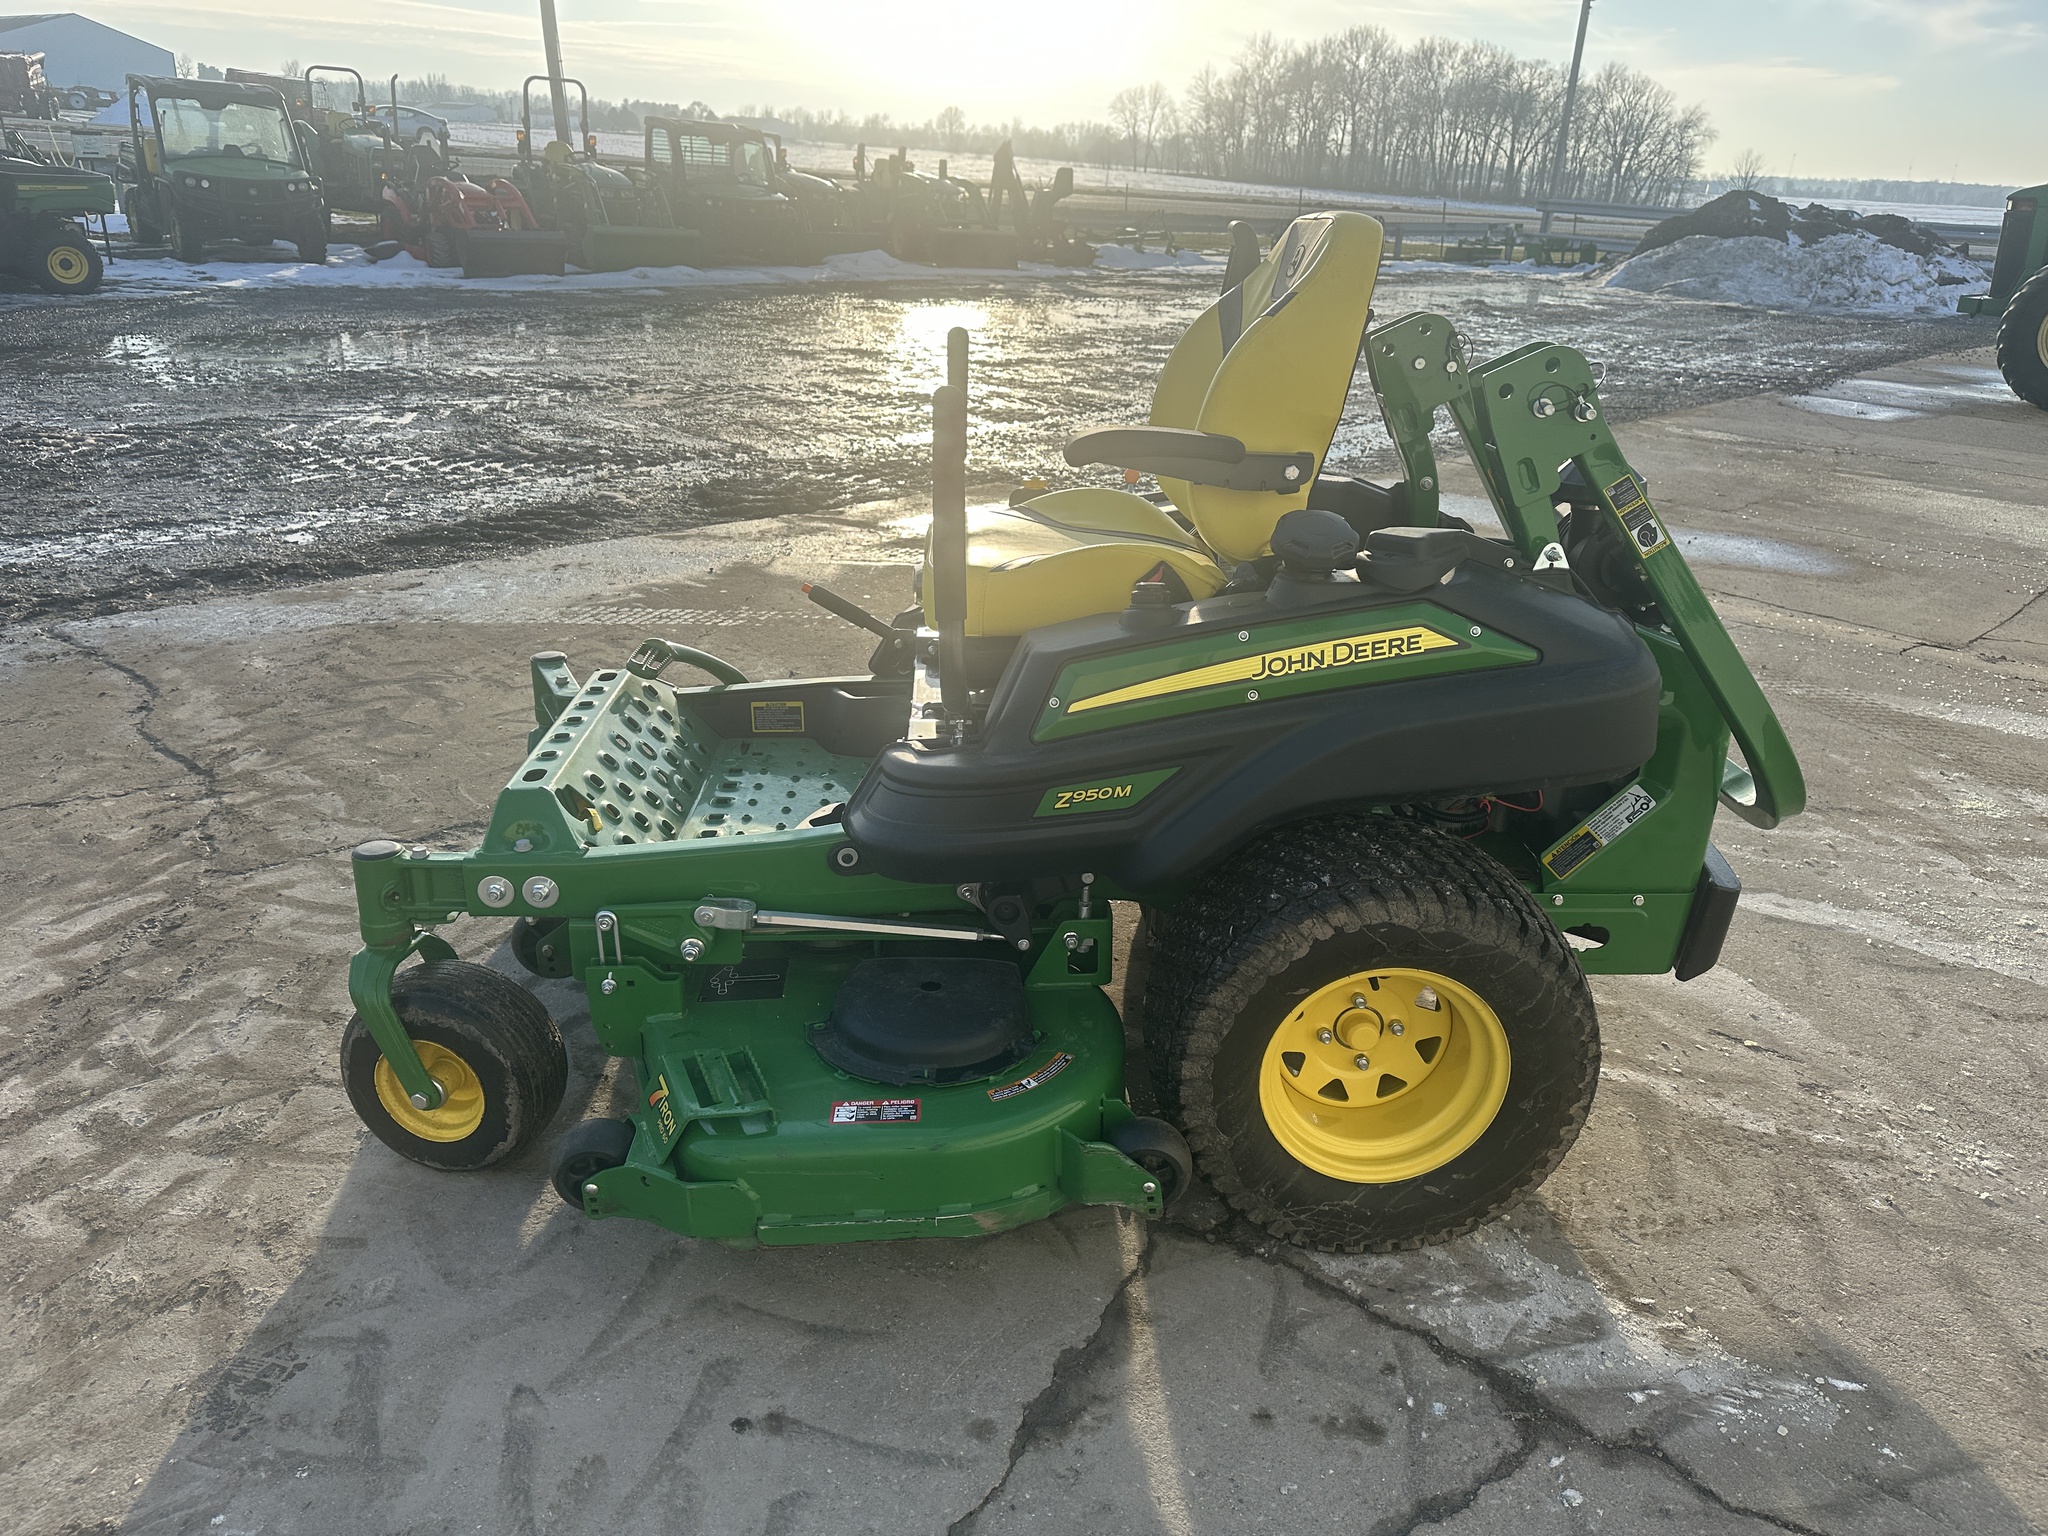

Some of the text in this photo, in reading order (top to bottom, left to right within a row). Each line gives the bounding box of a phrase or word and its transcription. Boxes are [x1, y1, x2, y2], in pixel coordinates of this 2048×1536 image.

[1251, 634, 1423, 679] JOHN DEERE
[1556, 833, 1581, 854] ATENCIÓN
